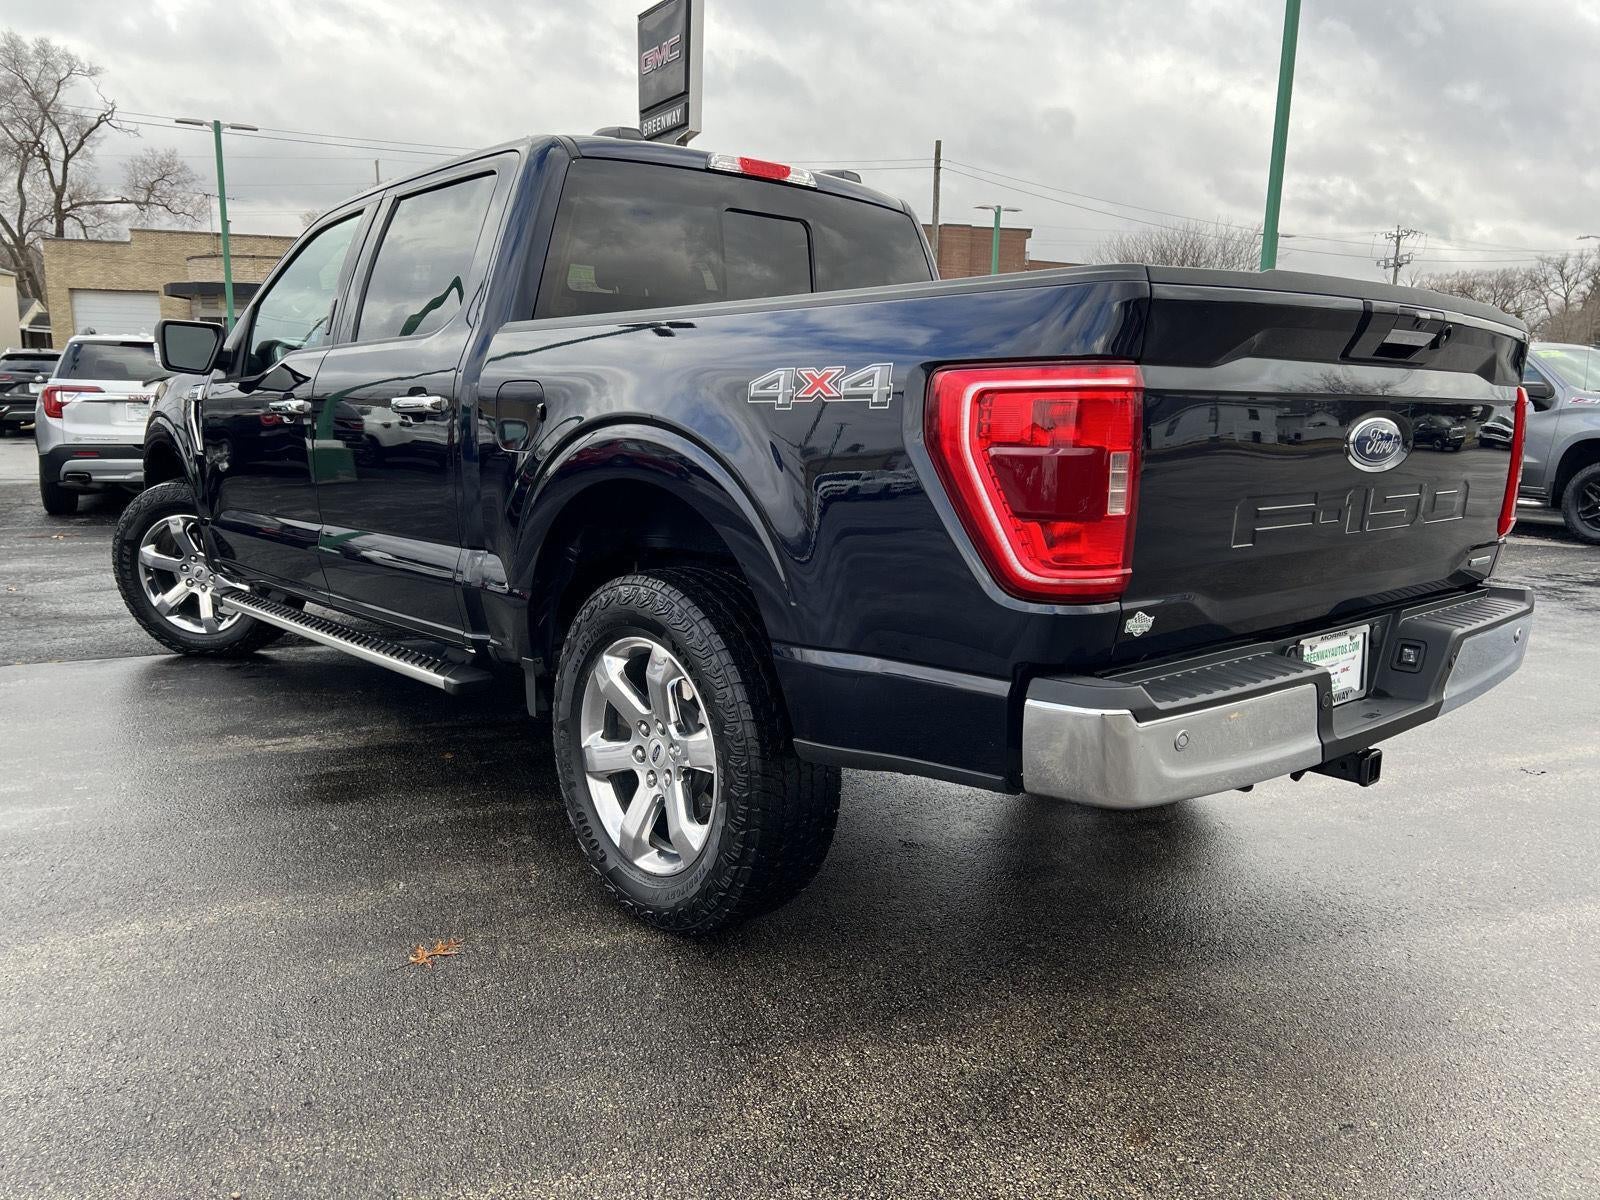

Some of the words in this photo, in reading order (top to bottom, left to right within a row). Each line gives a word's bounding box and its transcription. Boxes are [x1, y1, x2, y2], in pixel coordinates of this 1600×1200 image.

[641, 34, 681, 75] GMC
[642, 108, 681, 137] GREENWAY
[1365, 427, 1395, 455] Ford
[1231, 479, 1470, 549] F-150
[1320, 630, 1349, 642] MORRIS
